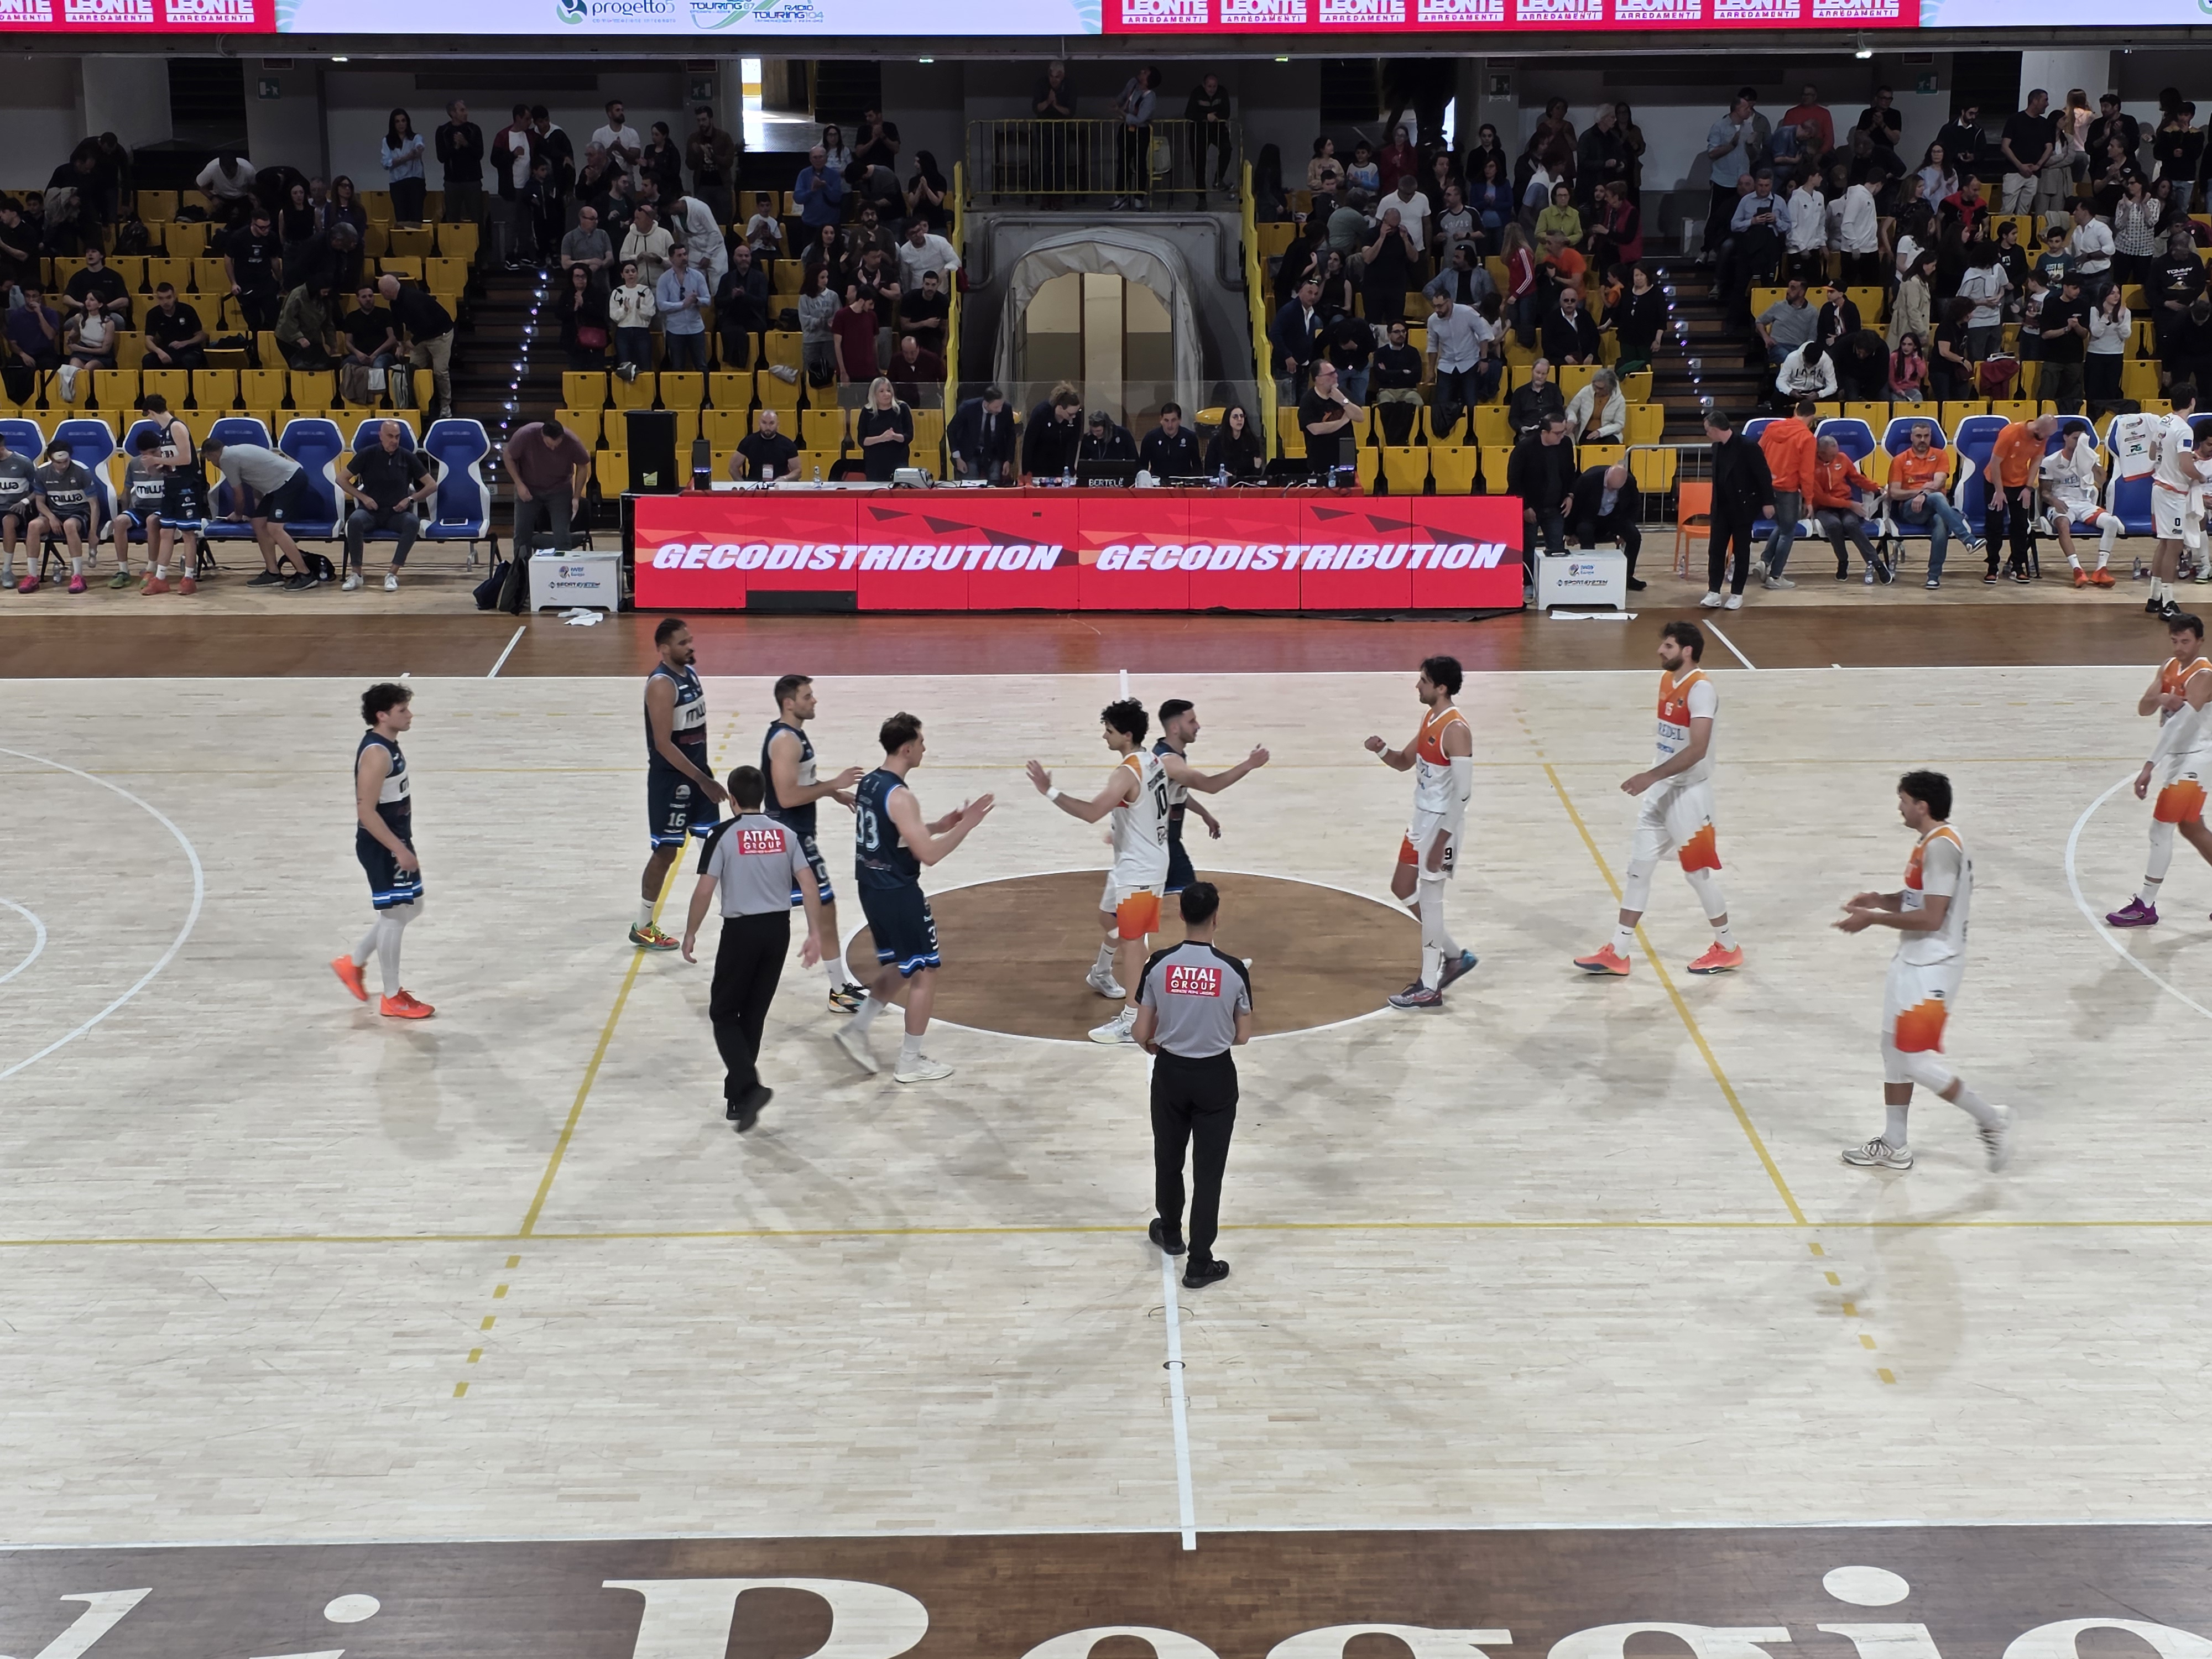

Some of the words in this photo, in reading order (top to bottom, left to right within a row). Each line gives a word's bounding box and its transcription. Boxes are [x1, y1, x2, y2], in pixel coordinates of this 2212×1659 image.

[0, 0, 51, 12] NTE
[65, 0, 152, 13] LEONTE
[166, 0, 253, 13] LEONTE
[1123, 0, 1208, 14] LEONTE
[1221, 0, 1306, 14] LEONTE
[1319, 0, 1405, 13] LEONTE
[137, 484, 163, 494] miw
[2174, 518, 2181, 526] 0
[653, 544, 1062, 570] GECODISTRIBUTION
[1097, 544, 1505, 570] GECODISTRIBUTION
[667, 812, 687, 827] 16
[743, 830, 780, 842] ATTAL
[743, 841, 781, 850] GROUP
[1444, 847, 1452, 860] 9
[1171, 966, 1216, 982] ATTAL
[1170, 979, 1216, 991] GROUP
